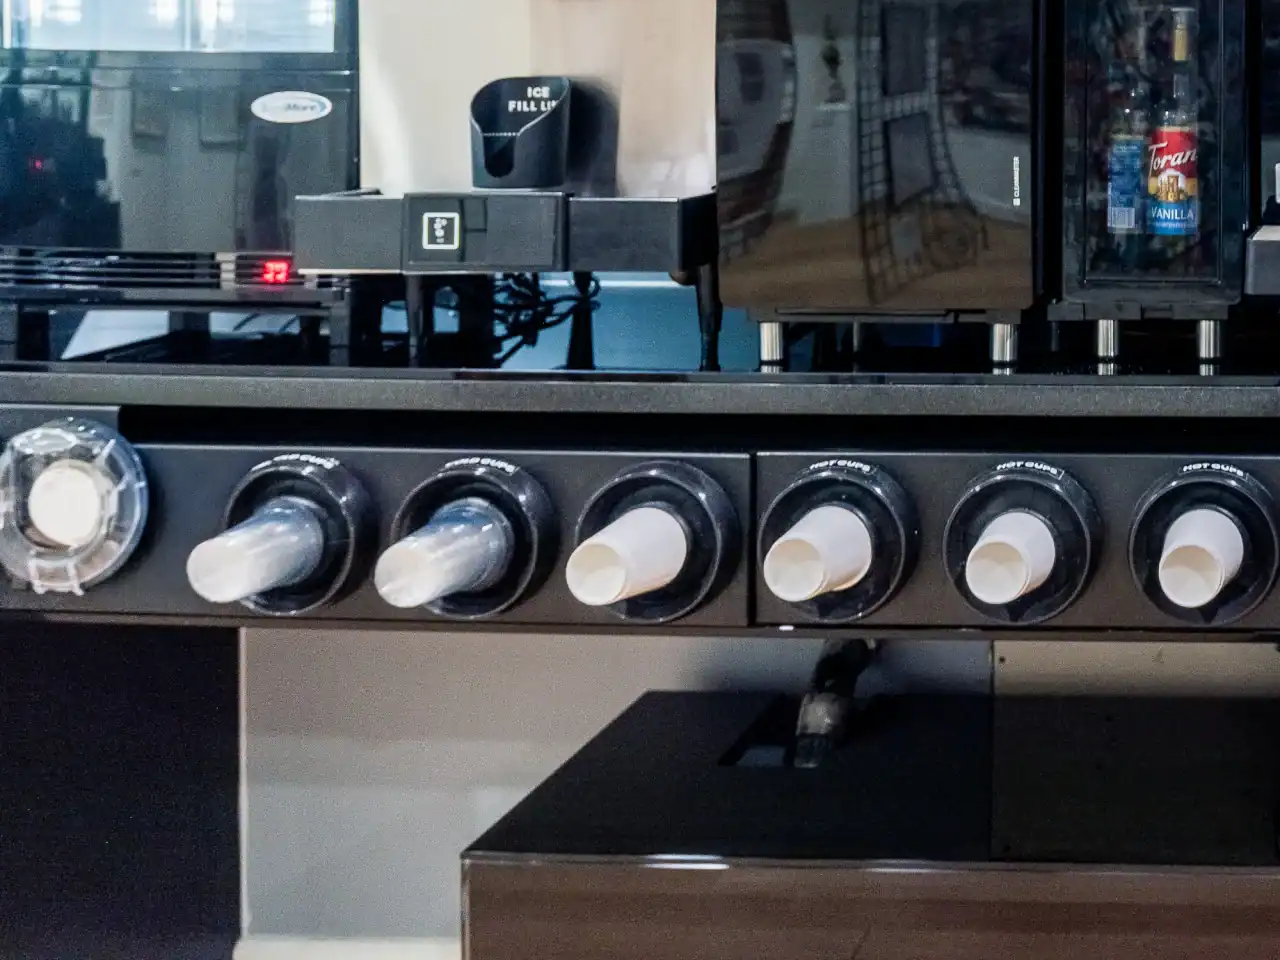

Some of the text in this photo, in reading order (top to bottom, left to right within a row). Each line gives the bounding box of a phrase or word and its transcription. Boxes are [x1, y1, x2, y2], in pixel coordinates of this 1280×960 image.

[527, 86, 550, 98] ICE
[508, 100, 557, 112] FILL LI
[1151, 206, 1194, 220] VANILLA
[809, 460, 871, 472] HOT CUPS
[996, 461, 1058, 474] HOT CUPS
[1182, 463, 1244, 477] HOT CUPS
